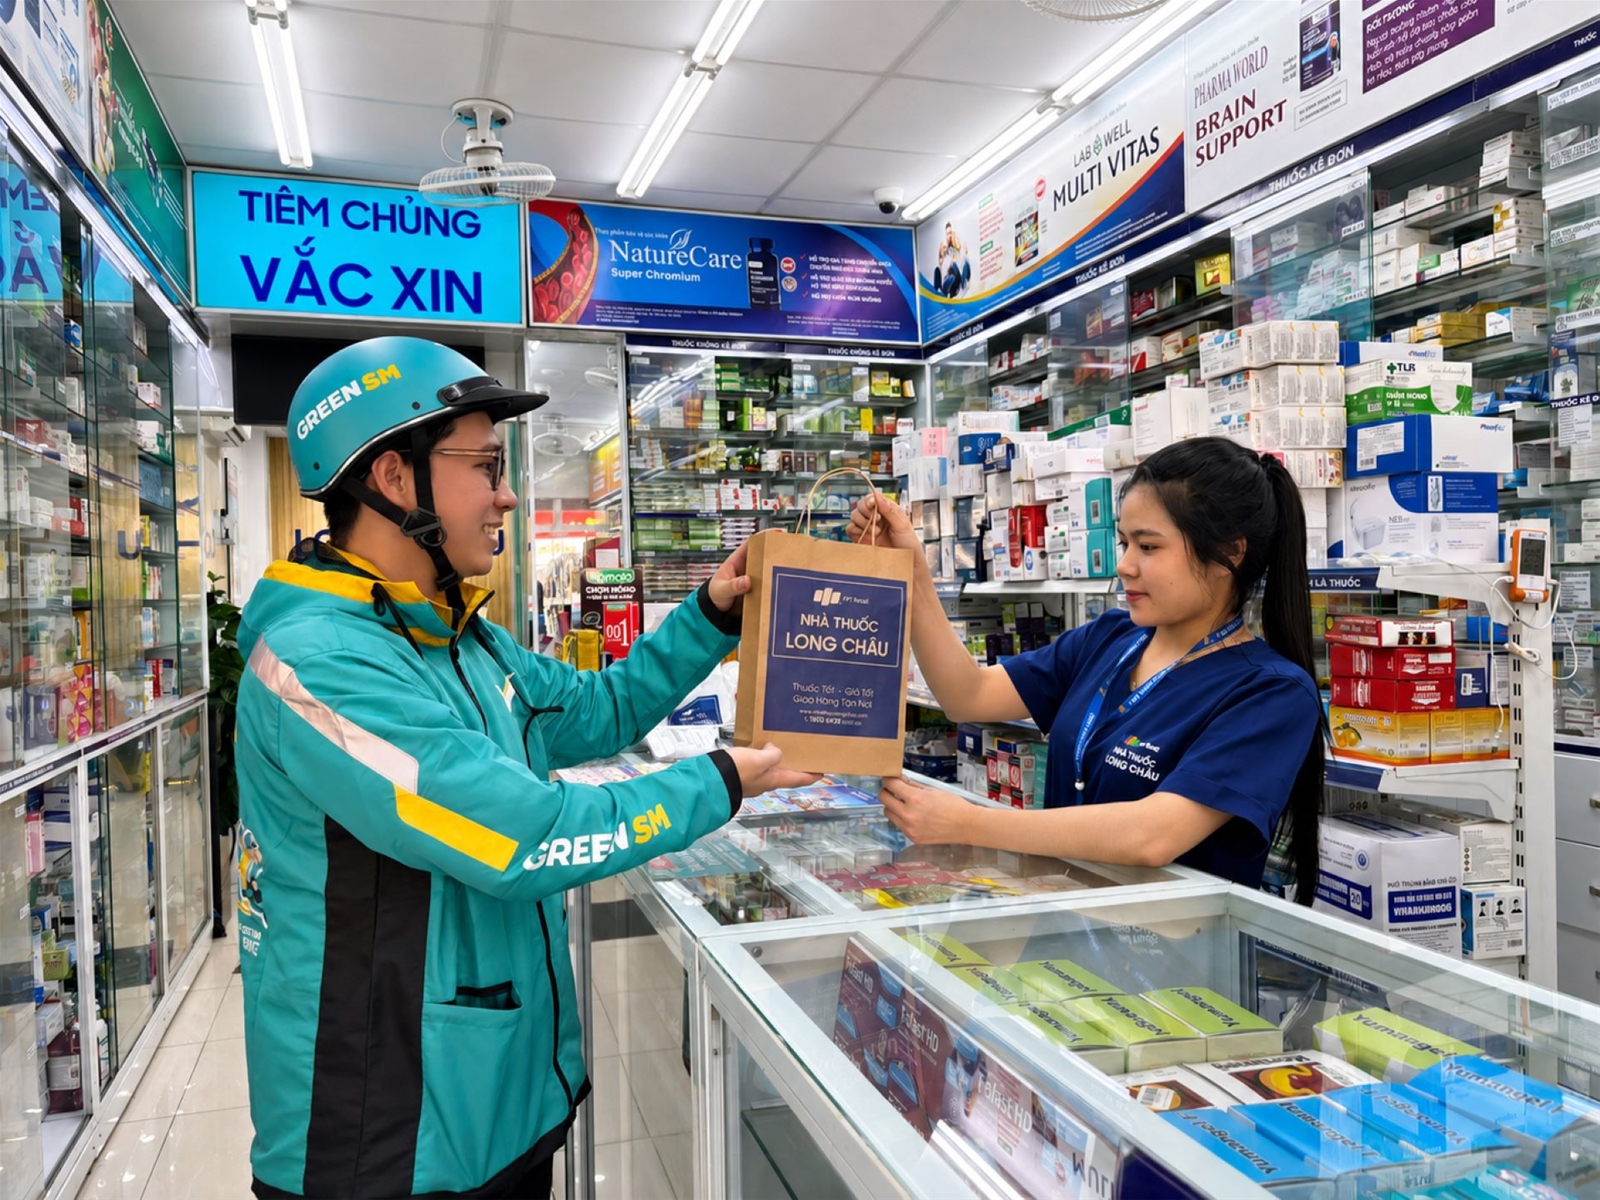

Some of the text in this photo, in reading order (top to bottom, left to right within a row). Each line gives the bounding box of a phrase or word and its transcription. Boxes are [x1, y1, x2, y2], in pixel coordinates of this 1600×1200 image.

[1194, 67, 1232, 110] PHARMA
[1233, 45, 1269, 84] WORLD
[1195, 88, 1257, 142] BRAIN
[1195, 98, 1288, 168] SUPPORT
[1073, 118, 1132, 168] LAB WELL
[1053, 125, 1160, 212] MULTI VITAS
[1268, 166, 1307, 195] THUỐC
[238, 185, 482, 239] TIÊM CHỦNG
[239, 236, 483, 315] VẮC XIN
[609, 238, 743, 270] NatureCare
[611, 267, 701, 283] Super Chromium
[296, 363, 402, 441] GREEN SM
[1314, 575, 1361, 588] LÀ THUỐC
[785, 631, 889, 657] LONG CHÂU
[800, 611, 879, 633] NHÀ THUỐC
[792, 682, 820, 693] Thuốc
[821, 684, 835, 694] Tốt
[1105, 754, 1161, 782] LONG CHÂU
[1127, 750, 1157, 769] THUỐC
[522, 821, 630, 872] GREEN
[632, 803, 672, 845] SM
[1352, 1013, 1458, 1058] Yumangel
[1443, 1061, 1552, 1109] Yumangel
[1014, 1105, 1033, 1133] HD
[1191, 1119, 1280, 1176] Yumangel
